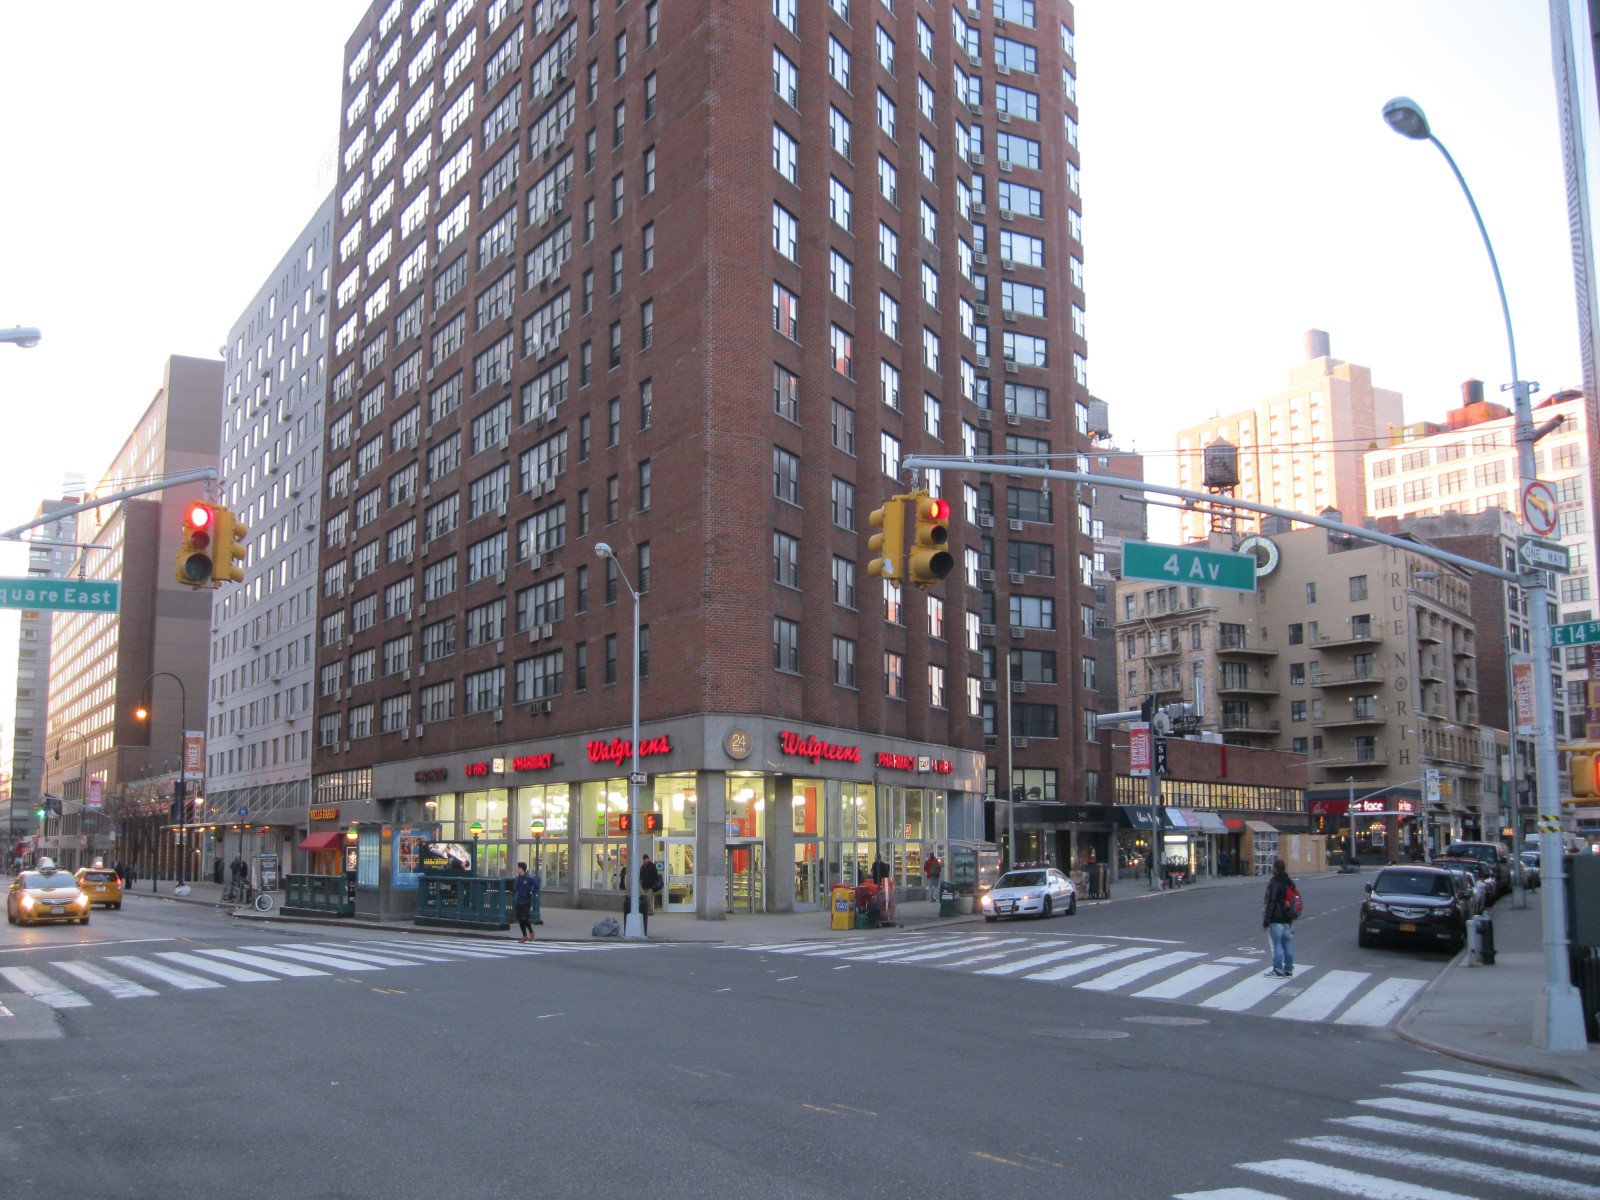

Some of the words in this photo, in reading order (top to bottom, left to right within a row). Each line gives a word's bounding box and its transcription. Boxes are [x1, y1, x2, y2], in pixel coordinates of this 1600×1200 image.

[1163, 553, 1180, 576] 4
[1189, 556, 1220, 580] Av
[1525, 546, 1541, 560] ONE
[1547, 553, 1563, 565] WAY
[64, 588, 110, 604] East
[1390, 549, 1403, 636] TRUE
[1555, 627, 1564, 645] E
[1570, 624, 1585, 643] 14
[1519, 675, 1530, 718] EXPRESS
[586, 735, 671, 766] Walgrens
[732, 734, 747, 747] 24
[780, 730, 862, 764] Walgreens
[1131, 736, 1139, 765] EXPRESS
[1138, 733, 1146, 765] YOURSELF
[188, 743, 199, 768] TWEET
[473, 761, 488, 775] HRS
[513, 753, 552, 771] PHARMACY
[878, 751, 915, 771] PHARMACY
[1158, 746, 1166, 772] SPA
[1363, 800, 1384, 811] face
